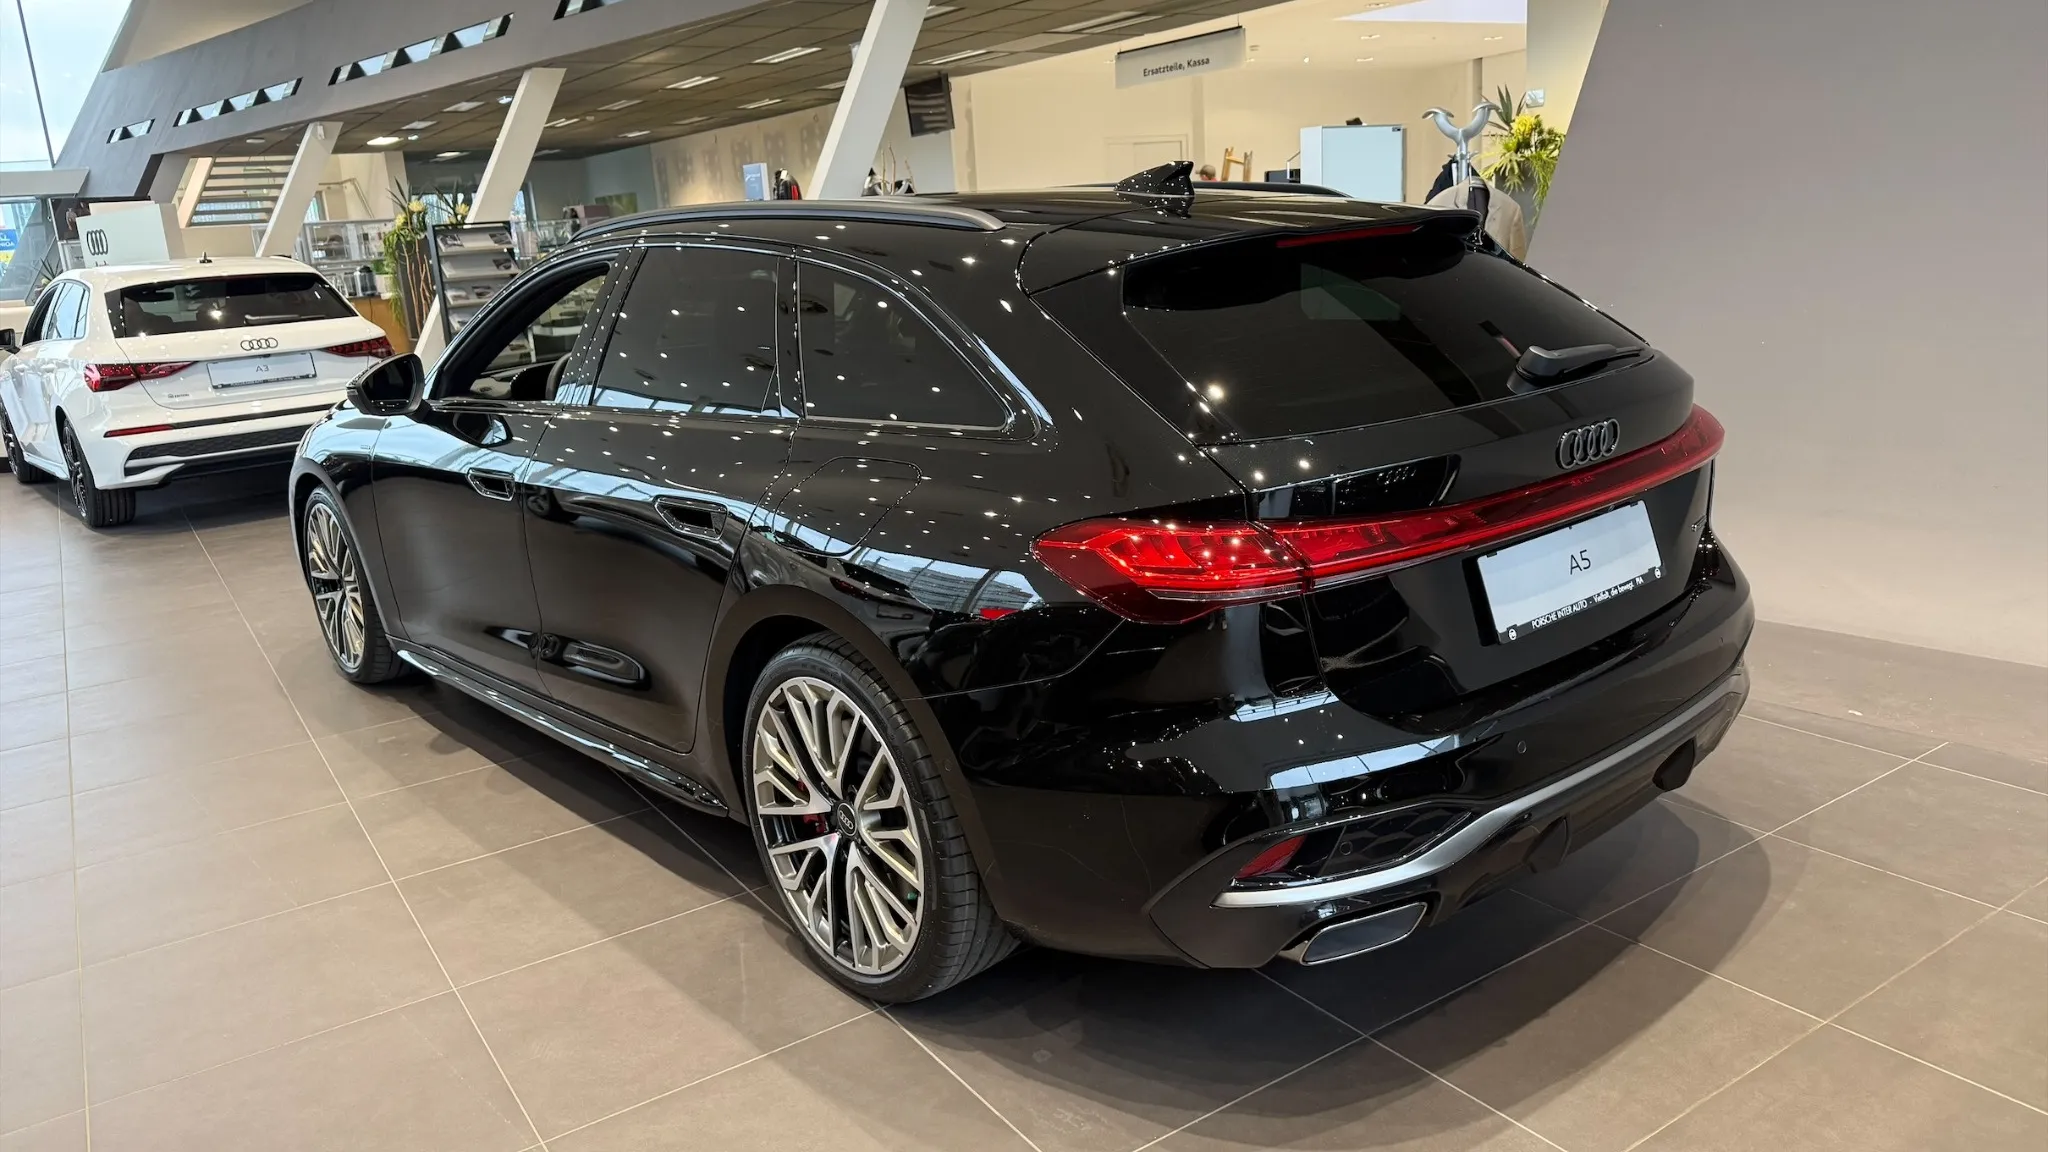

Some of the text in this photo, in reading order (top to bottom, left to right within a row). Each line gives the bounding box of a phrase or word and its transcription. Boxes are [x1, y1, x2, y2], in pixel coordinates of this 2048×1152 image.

[1143, 57, 1210, 77] Ersatzteile, Kassa
[256, 364, 270, 373] A3
[1570, 549, 1591, 575] A5
[1531, 611, 1557, 629] PORSCHE
[1556, 605, 1573, 619] INTER
[1572, 599, 1588, 613] AUTO
